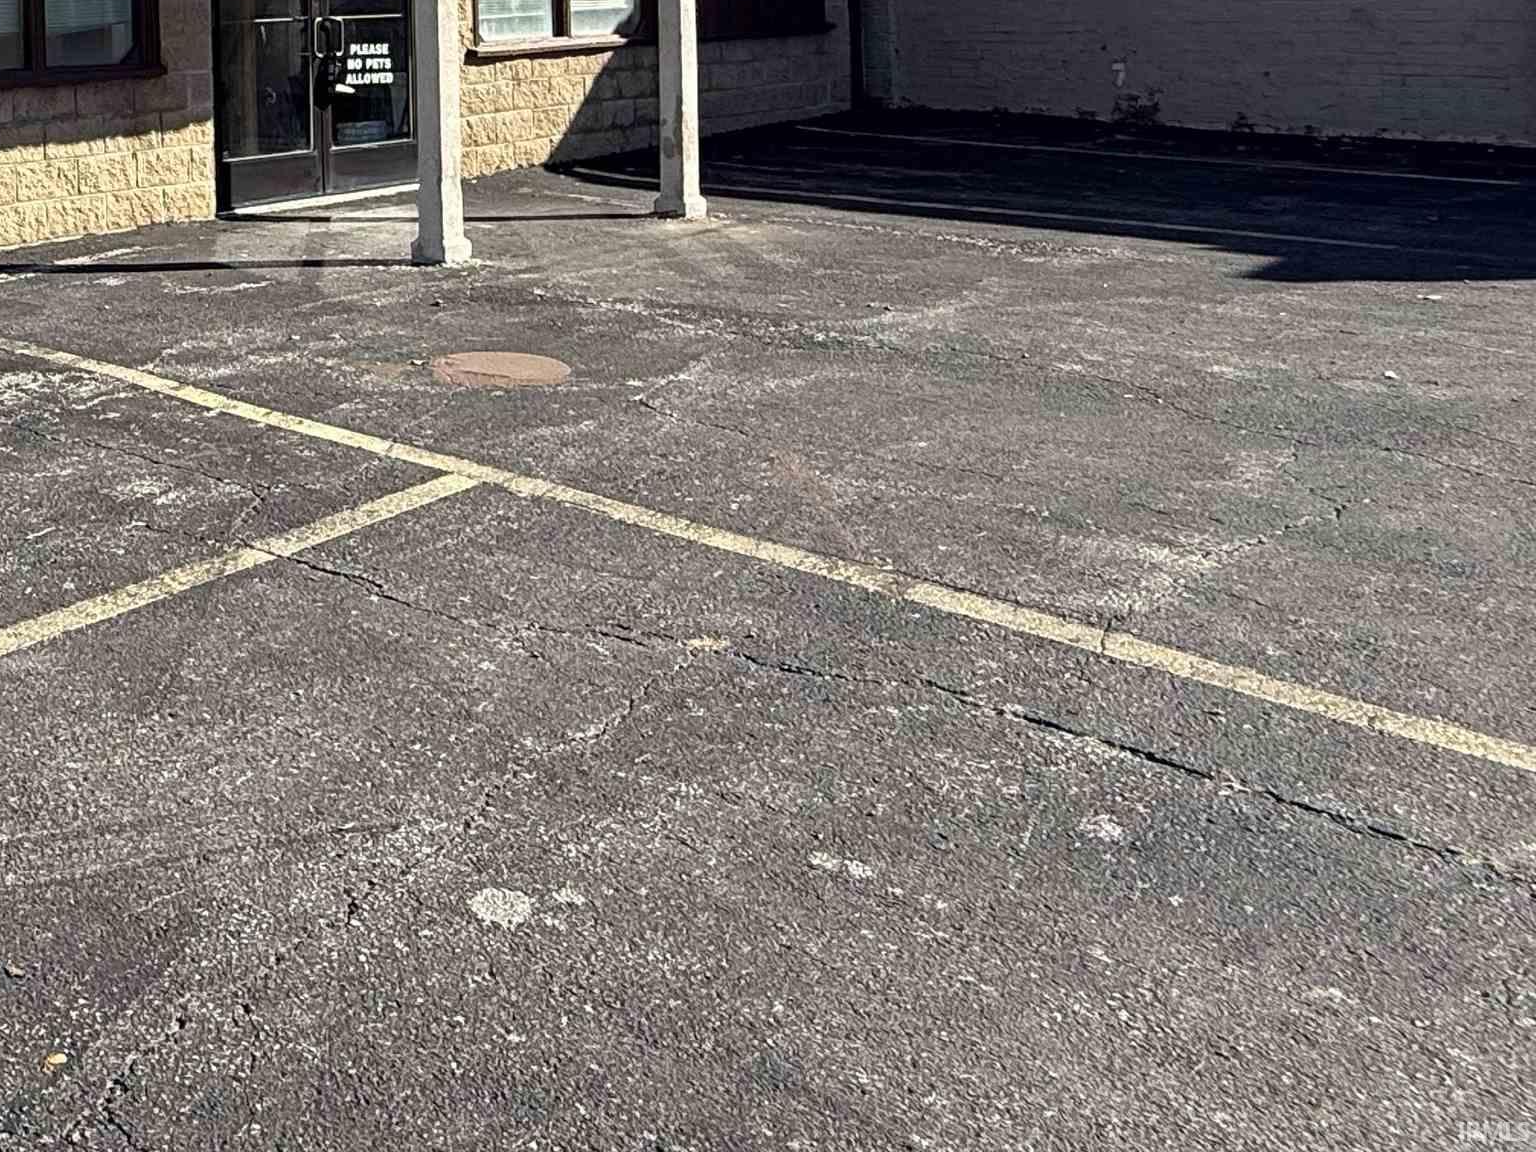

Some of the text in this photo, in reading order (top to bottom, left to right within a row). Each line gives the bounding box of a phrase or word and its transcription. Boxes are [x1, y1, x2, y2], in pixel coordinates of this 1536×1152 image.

[349, 43, 389, 55] PLEASE
[347, 58, 392, 70] NO PETS
[345, 71, 394, 85] ALLOWED
